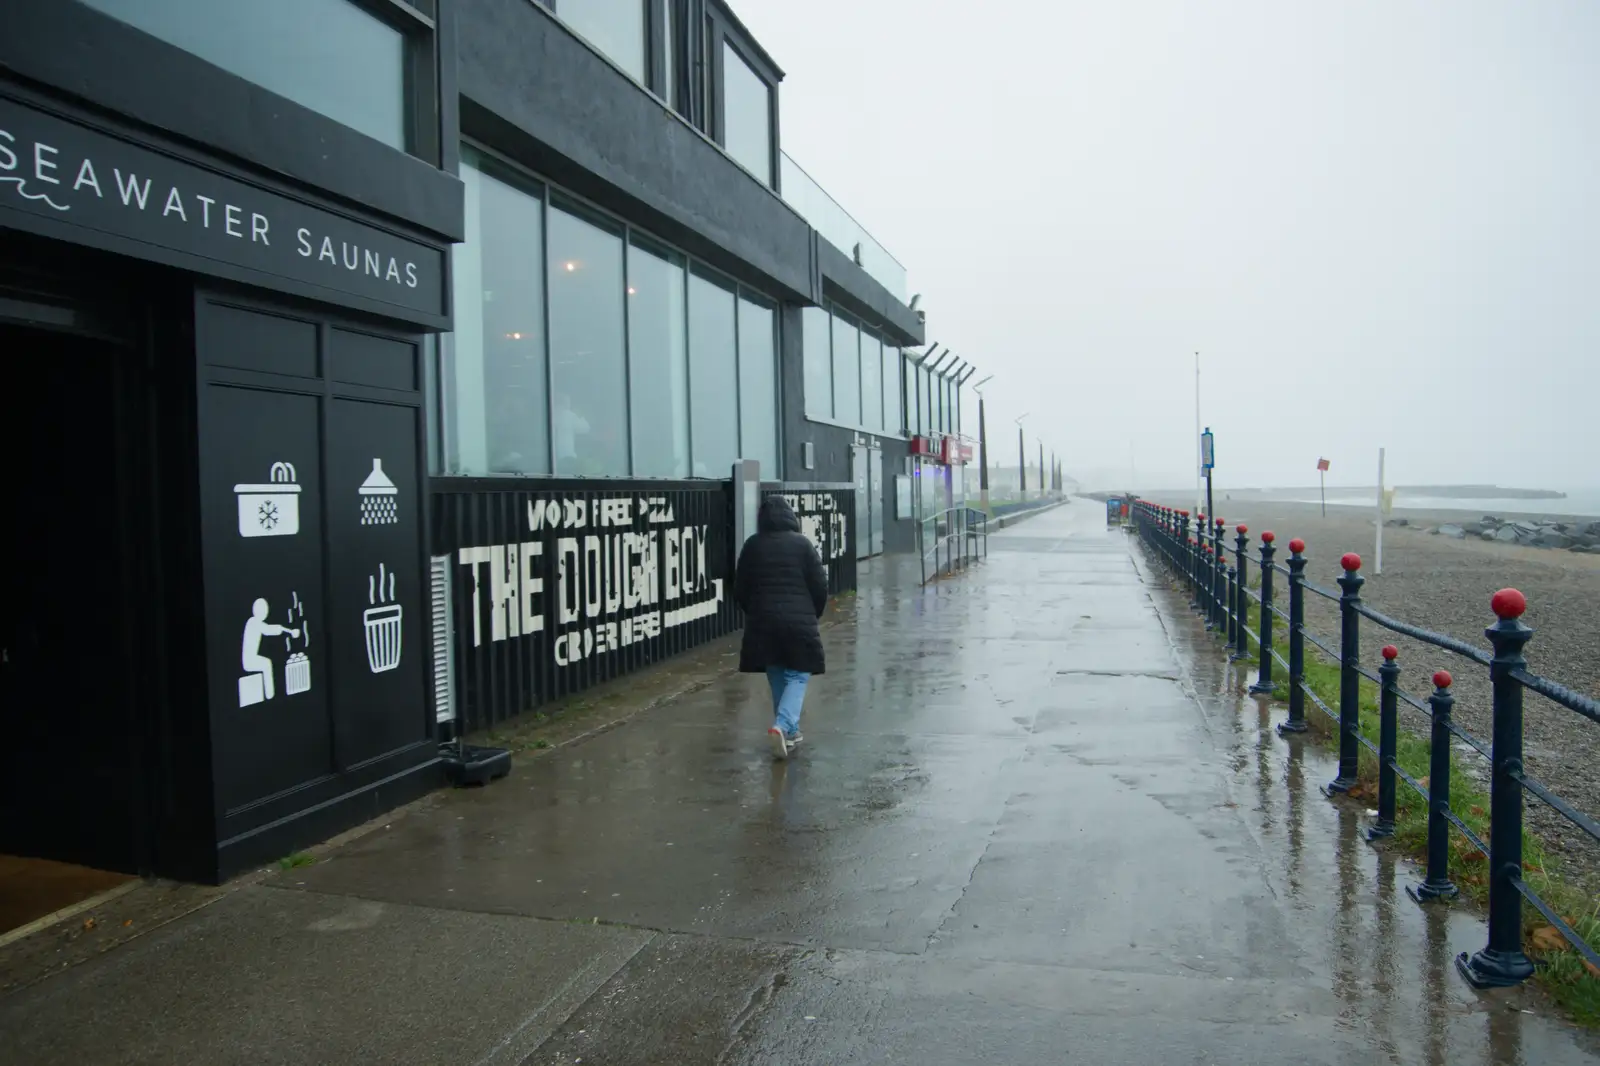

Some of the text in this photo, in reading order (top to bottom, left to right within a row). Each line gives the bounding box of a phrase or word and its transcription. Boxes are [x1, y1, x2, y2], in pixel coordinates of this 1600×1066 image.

[0, 130, 418, 288] SEAWATER SAUNAS
[639, 497, 674, 523] PZZA
[459, 541, 544, 647] THE
[557, 531, 659, 624] DOUGH
[665, 525, 708, 600] BOX
[621, 610, 661, 647] HERE
